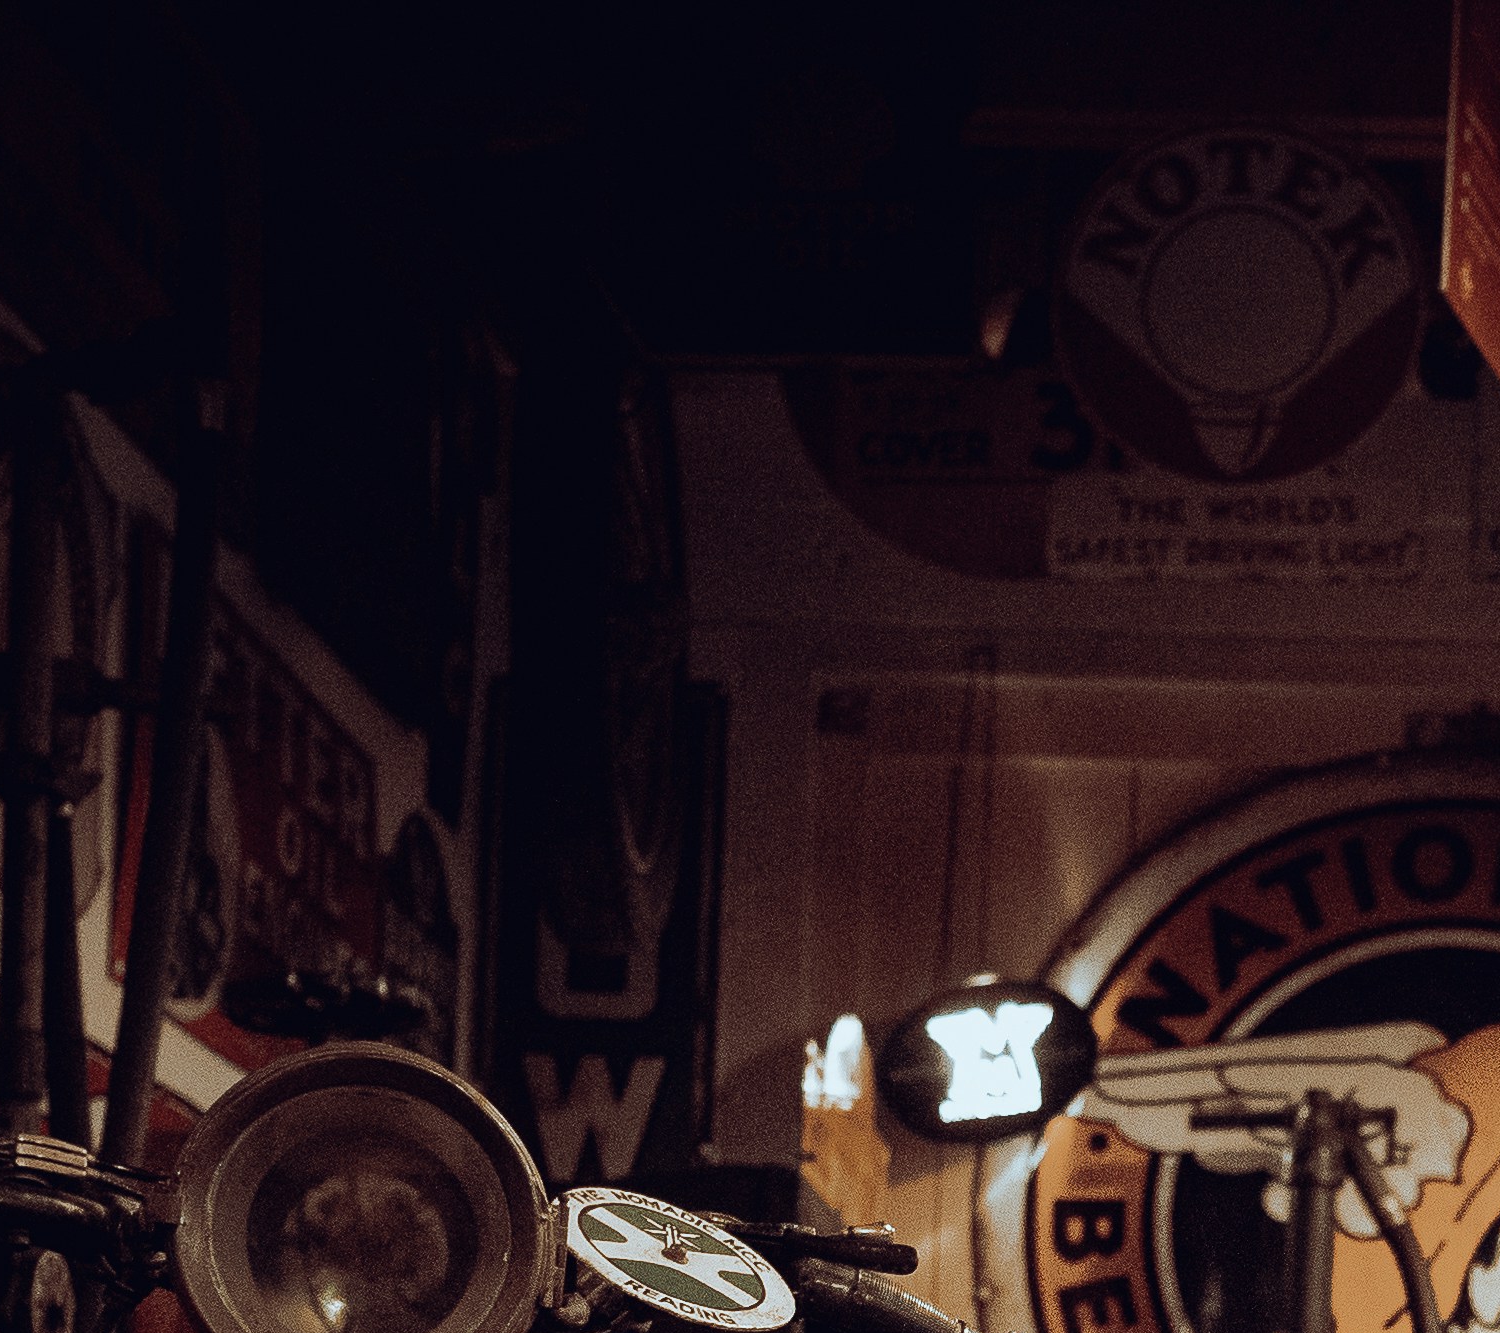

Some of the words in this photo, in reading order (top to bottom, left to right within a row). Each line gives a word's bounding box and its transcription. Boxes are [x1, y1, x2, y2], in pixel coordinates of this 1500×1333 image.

[1086, 137, 1400, 290] NOTEK
[1115, 497, 1186, 524] THE
[624, 1279, 737, 1326] READING
